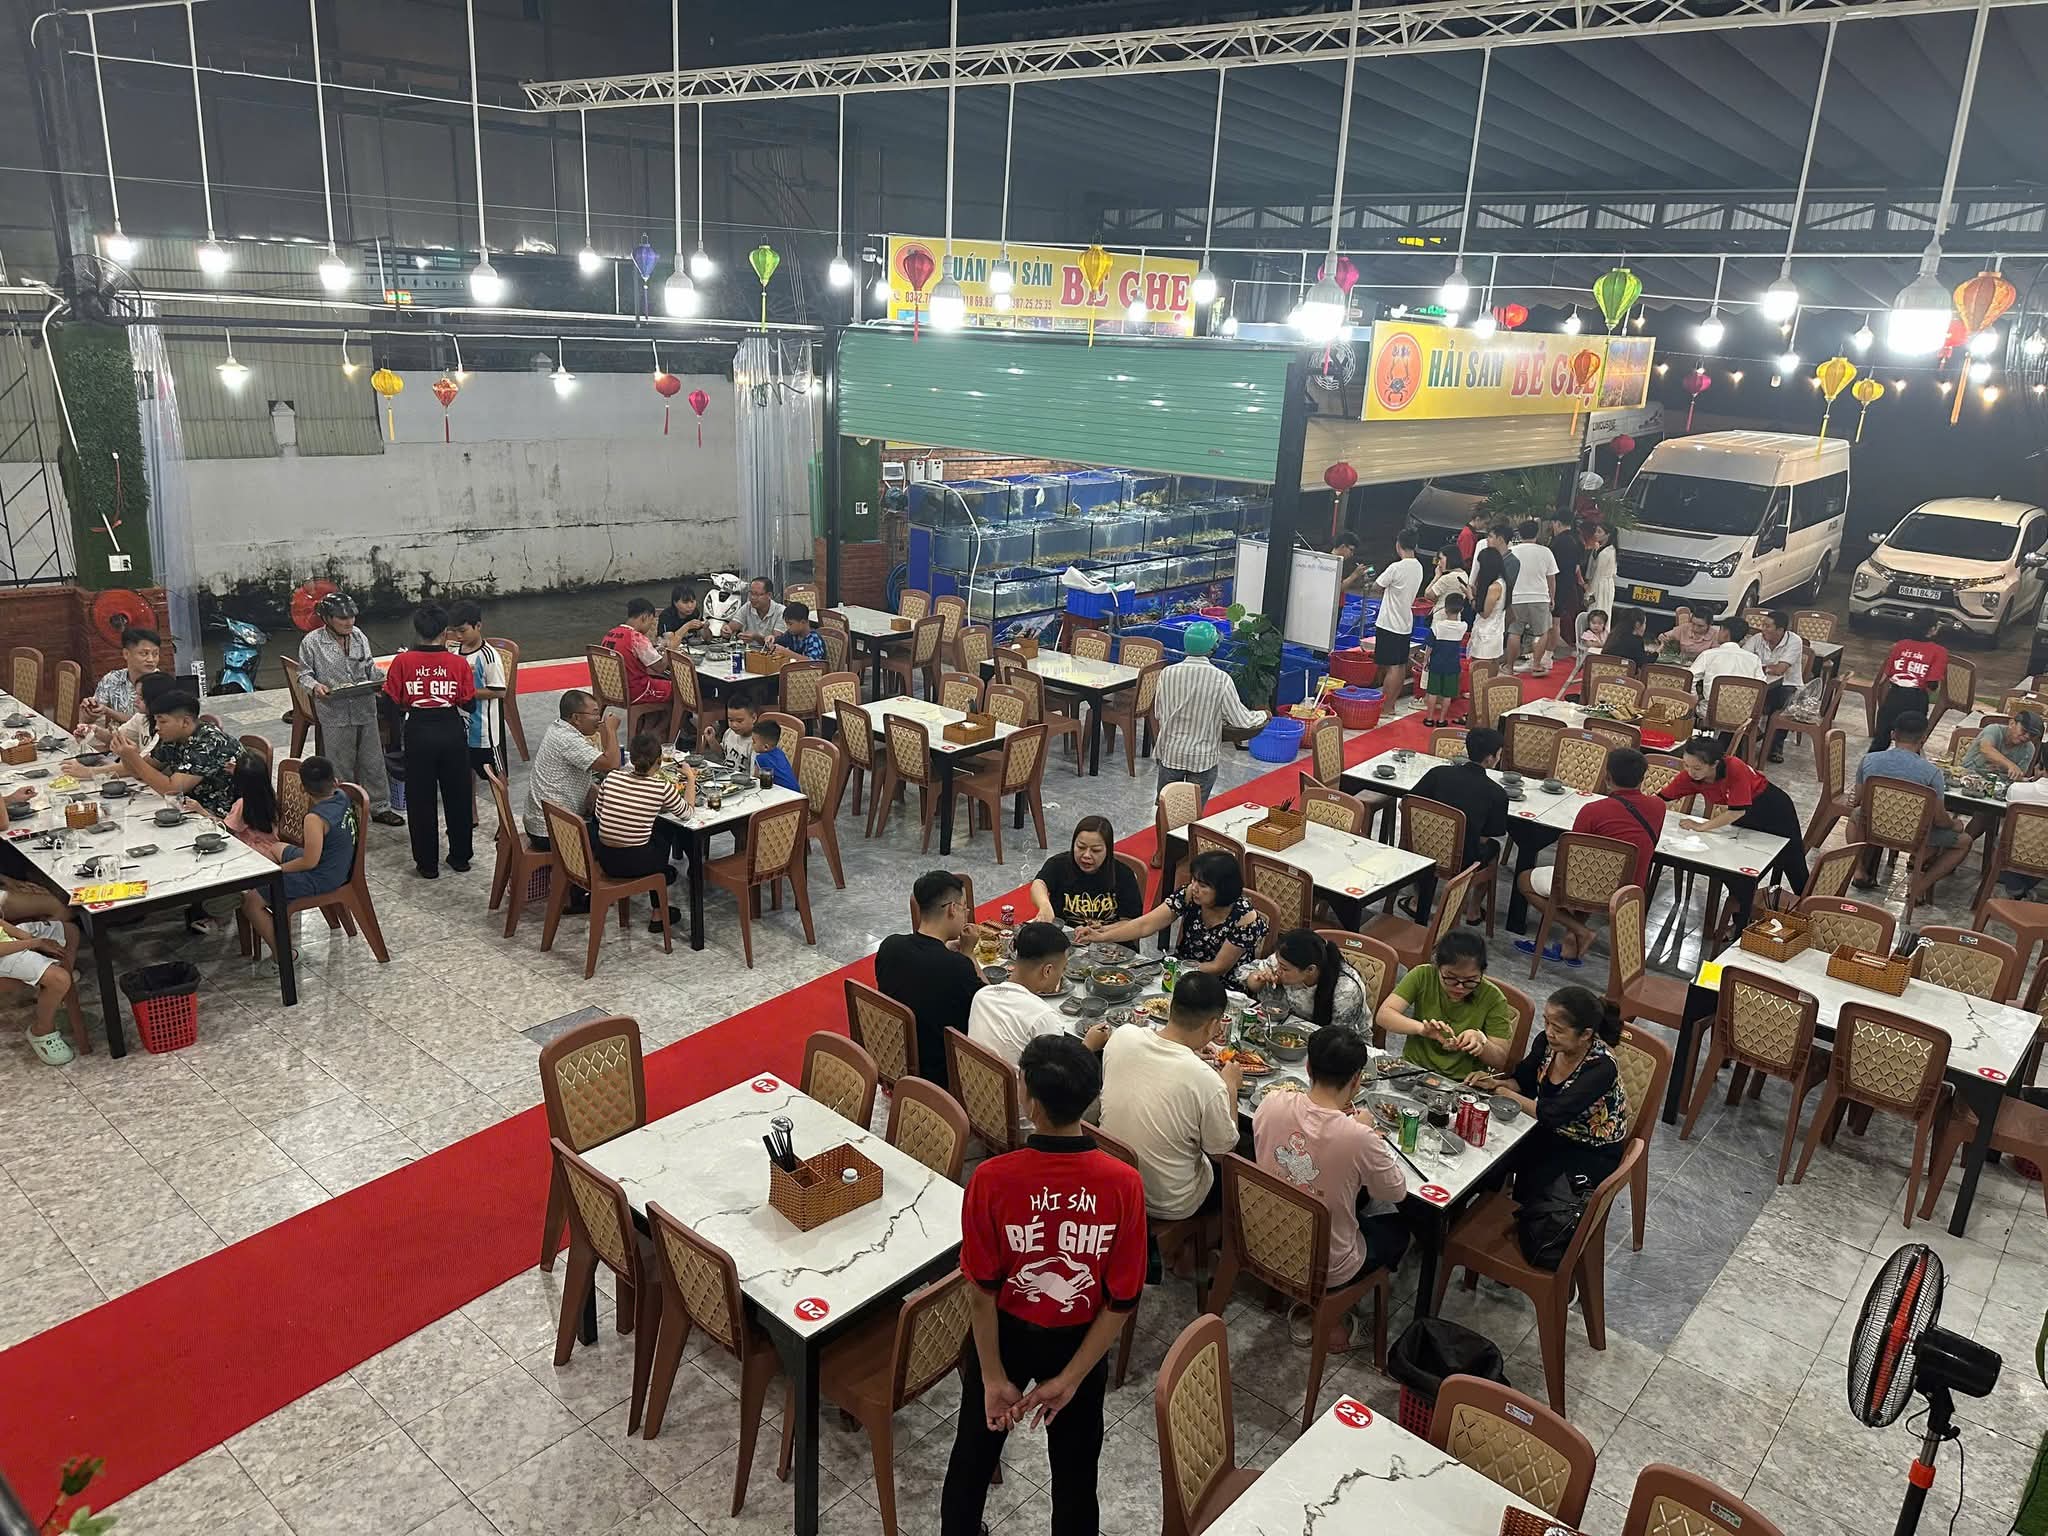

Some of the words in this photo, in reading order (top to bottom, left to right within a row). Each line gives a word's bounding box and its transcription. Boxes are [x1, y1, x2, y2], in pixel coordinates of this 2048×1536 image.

[1022, 256, 1053, 286] SẢN
[1427, 340, 1463, 387] HẢI
[416, 665, 430, 676] HẢI
[433, 665, 447, 677] SẢN
[405, 677, 424, 695] BÉ
[430, 681, 458, 698] GHẸ
[755, 1080, 777, 1091] 20
[1030, 1186, 1062, 1212] HẢI
[1067, 1186, 1097, 1215] SẢN
[1421, 1187, 1449, 1200] 27
[1005, 1215, 1045, 1253] BÉ
[1058, 1221, 1116, 1261] GHẸ
[798, 1300, 827, 1318] 20
[1336, 1403, 1369, 1426] 23
